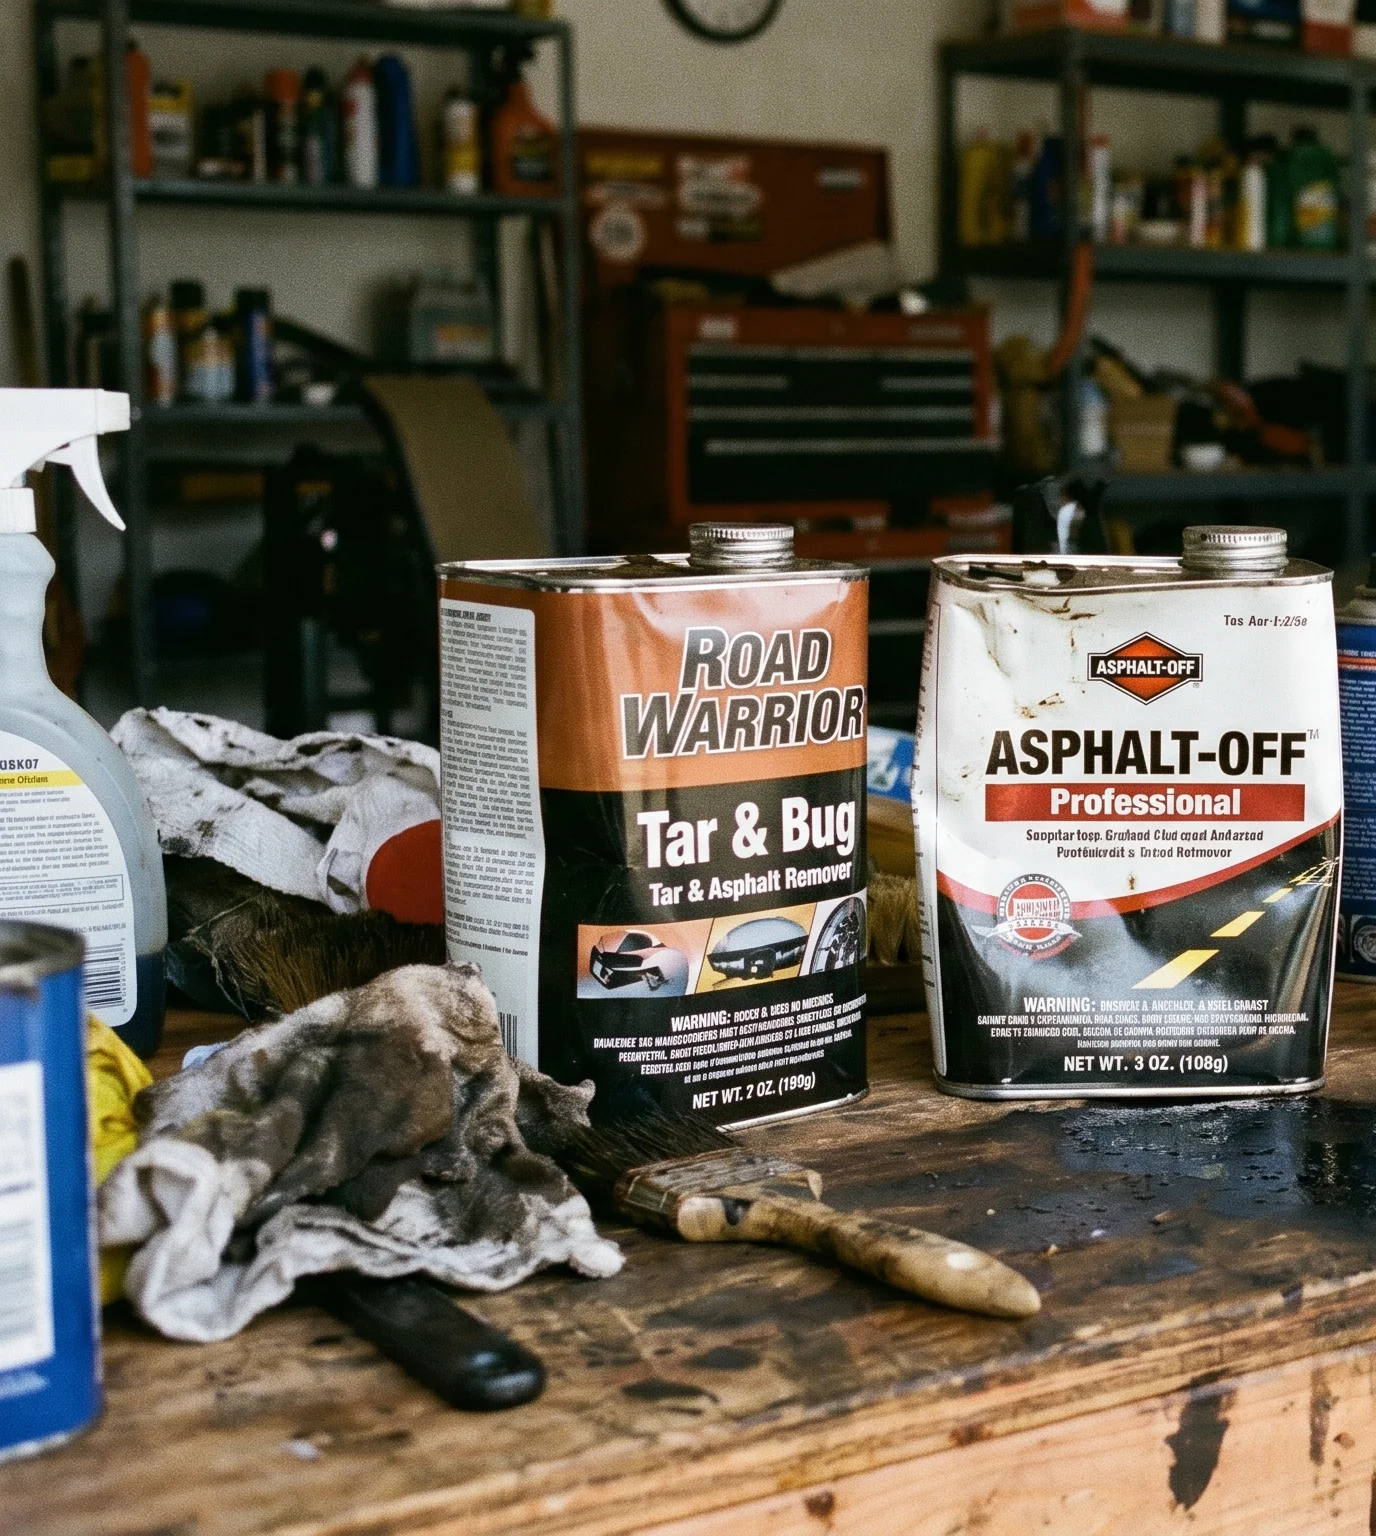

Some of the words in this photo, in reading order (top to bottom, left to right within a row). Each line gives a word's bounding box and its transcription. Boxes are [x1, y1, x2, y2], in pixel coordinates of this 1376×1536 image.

[679, 626, 832, 692] ROAD
[1096, 660, 1195, 675] ASPHALT-OFF
[620, 685, 865, 760] WARRIOR
[985, 729, 1307, 776] ASPHALT-OFF
[1050, 788, 1241, 816] Professional
[637, 810, 718, 868] Tar
[732, 801, 769, 858] &
[782, 796, 856, 856] Bug
[649, 882, 684, 907] Tar
[688, 879, 704, 902] &
[708, 872, 780, 902] Asphalt
[785, 862, 852, 891] Remover
[1024, 997, 1096, 1012] WARNING:
[671, 1010, 732, 1032] WARNING:
[1064, 1056, 1094, 1072] NET
[1099, 1056, 1128, 1071] WT.
[1134, 1056, 1144, 1071] 3
[1148, 1056, 1174, 1071] OZ.
[1180, 1055, 1228, 1074] (108g)
[692, 1090, 718, 1110] NET
[722, 1086, 744, 1104] WT.
[746, 1084, 754, 1100] 2
[756, 1080, 776, 1098] OZ.
